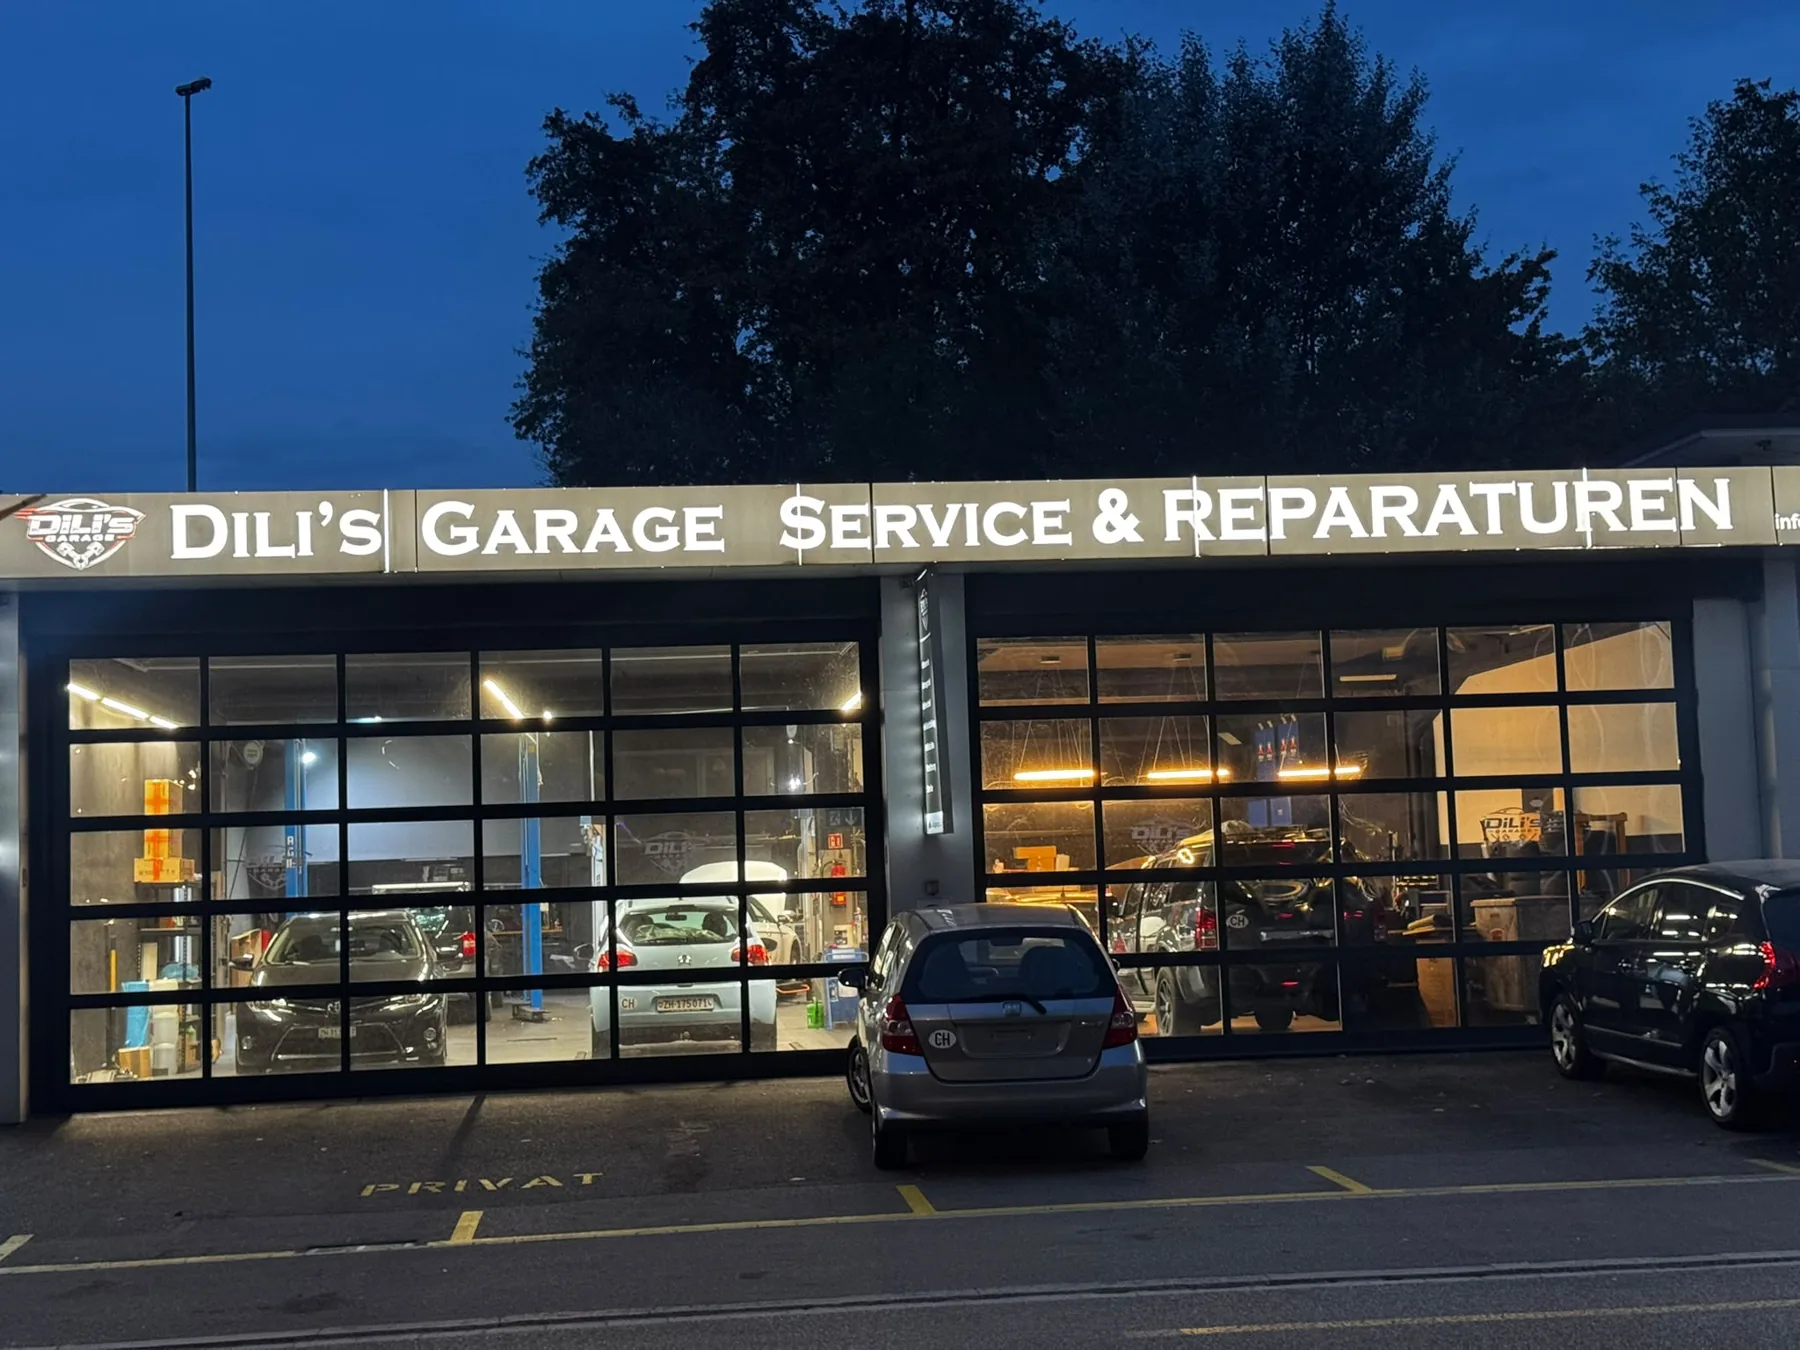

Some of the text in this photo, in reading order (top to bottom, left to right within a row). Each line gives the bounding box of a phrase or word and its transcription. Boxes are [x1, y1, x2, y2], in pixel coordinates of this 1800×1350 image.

[421, 501, 725, 556] GARAGE
[779, 495, 1073, 550] SERVICE
[1092, 487, 1144, 545] &
[1162, 477, 1734, 542] REPARATUREN
[1775, 512, 1800, 530] inf
[45, 534, 115, 543] GARAGE
[1230, 916, 1245, 927] CH
[621, 998, 636, 1009] CH
[934, 1033, 951, 1047] CH
[360, 1172, 604, 1197] PRIVAT
